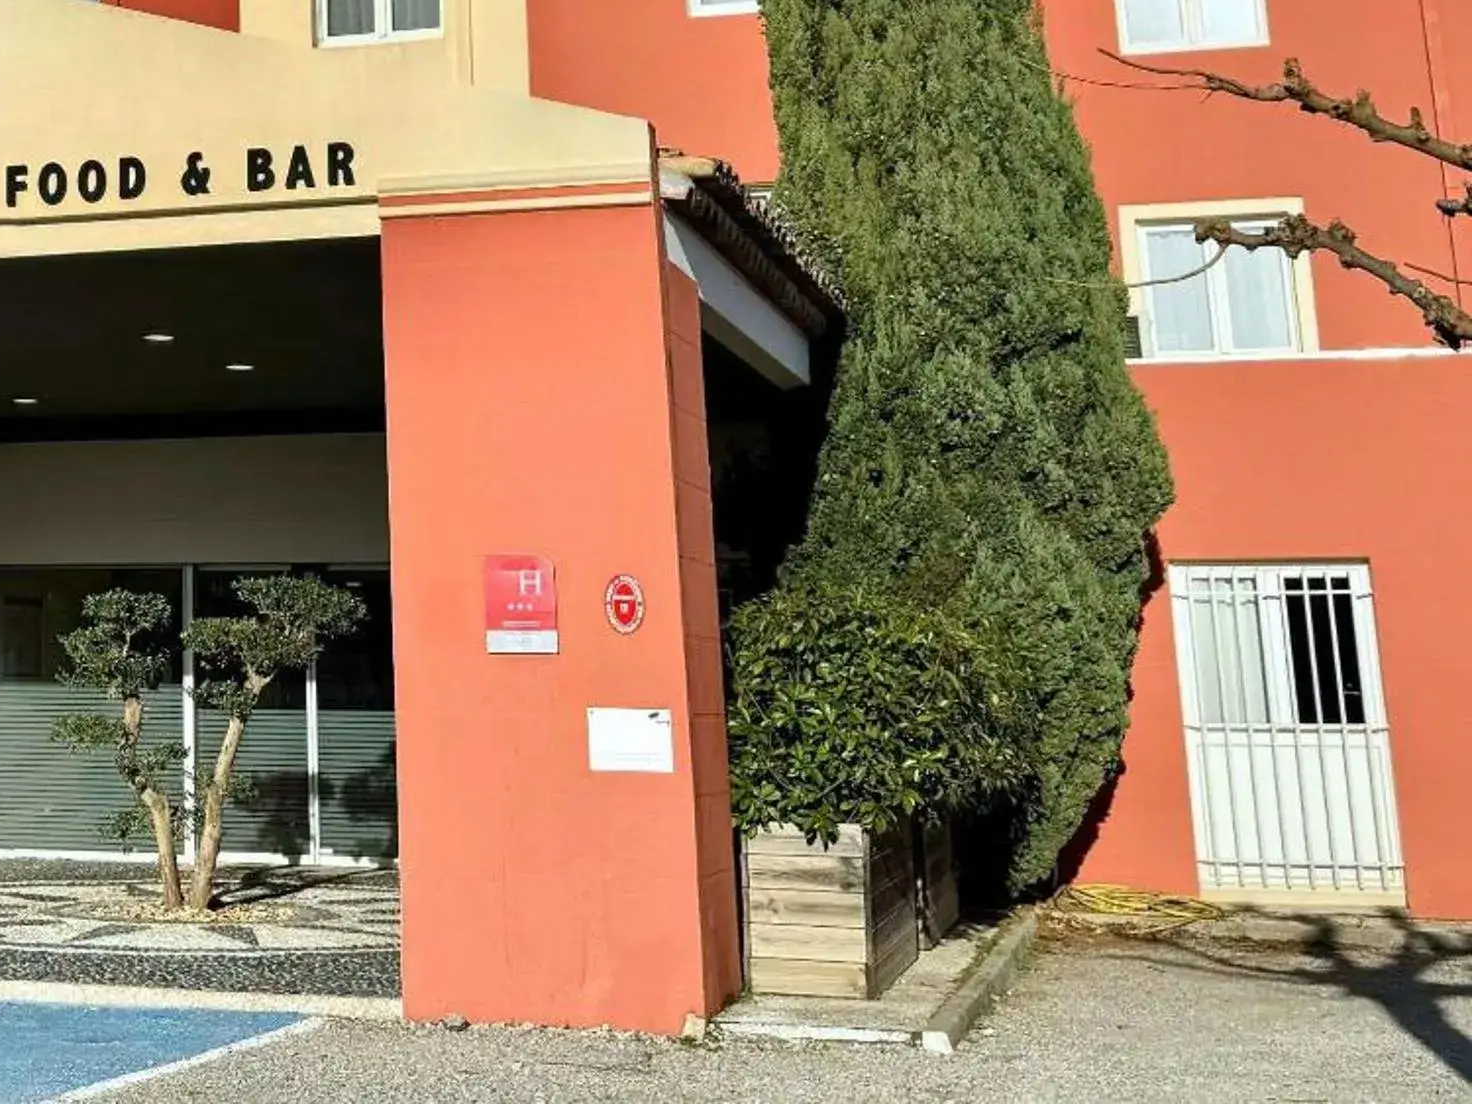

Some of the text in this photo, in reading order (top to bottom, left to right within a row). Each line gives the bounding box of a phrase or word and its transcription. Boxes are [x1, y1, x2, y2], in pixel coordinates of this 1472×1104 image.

[5, 155, 146, 208] FOOD
[180, 151, 212, 196] &
[245, 141, 356, 192] BAR
[518, 568, 543, 596] H
